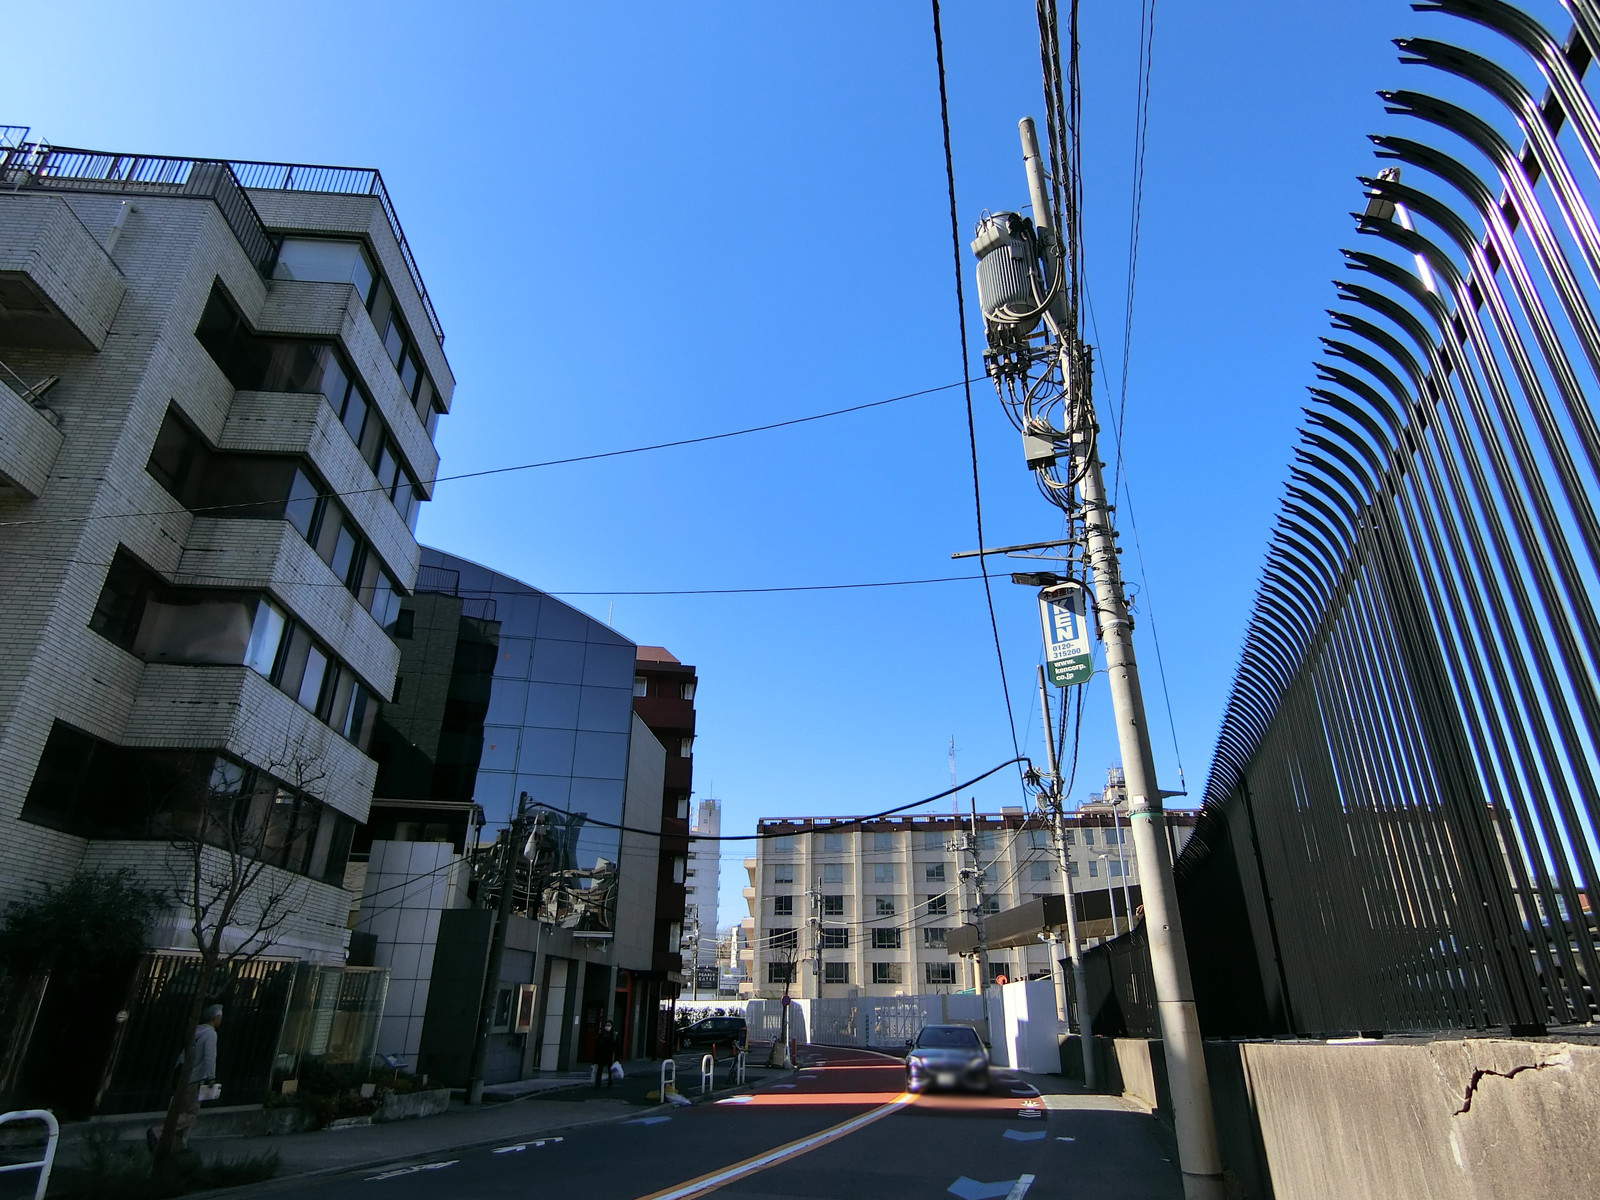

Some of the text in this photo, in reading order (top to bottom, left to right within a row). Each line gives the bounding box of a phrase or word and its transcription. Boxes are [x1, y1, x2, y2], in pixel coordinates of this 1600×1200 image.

[1053, 599, 1074, 642] KEN
[1052, 643, 1074, 652] 0120-
[1053, 648, 1081, 659] 315200
[1053, 659, 1076, 668] www.
[1055, 663, 1087, 675] kencorp.
[1055, 672, 1074, 681] co.jp
